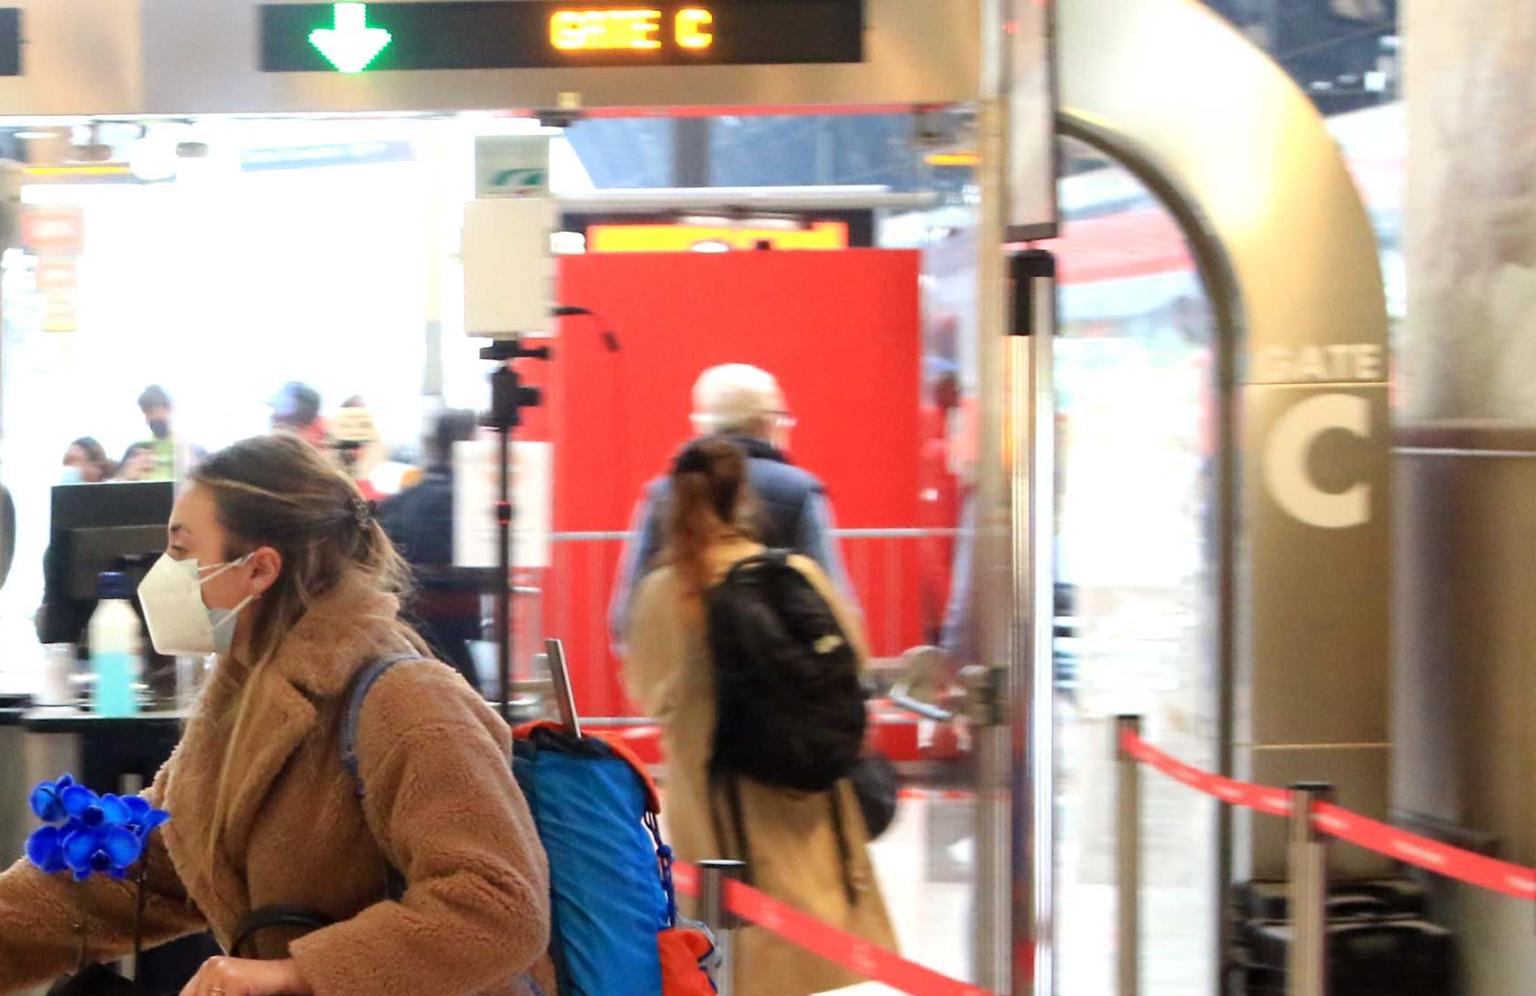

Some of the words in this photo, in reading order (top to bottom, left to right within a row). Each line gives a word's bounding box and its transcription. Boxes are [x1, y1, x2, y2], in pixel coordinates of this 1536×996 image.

[550, 9, 662, 50] GATE
[675, 8, 713, 49] C
[1259, 343, 1383, 381] GATE
[1265, 392, 1372, 529] C
